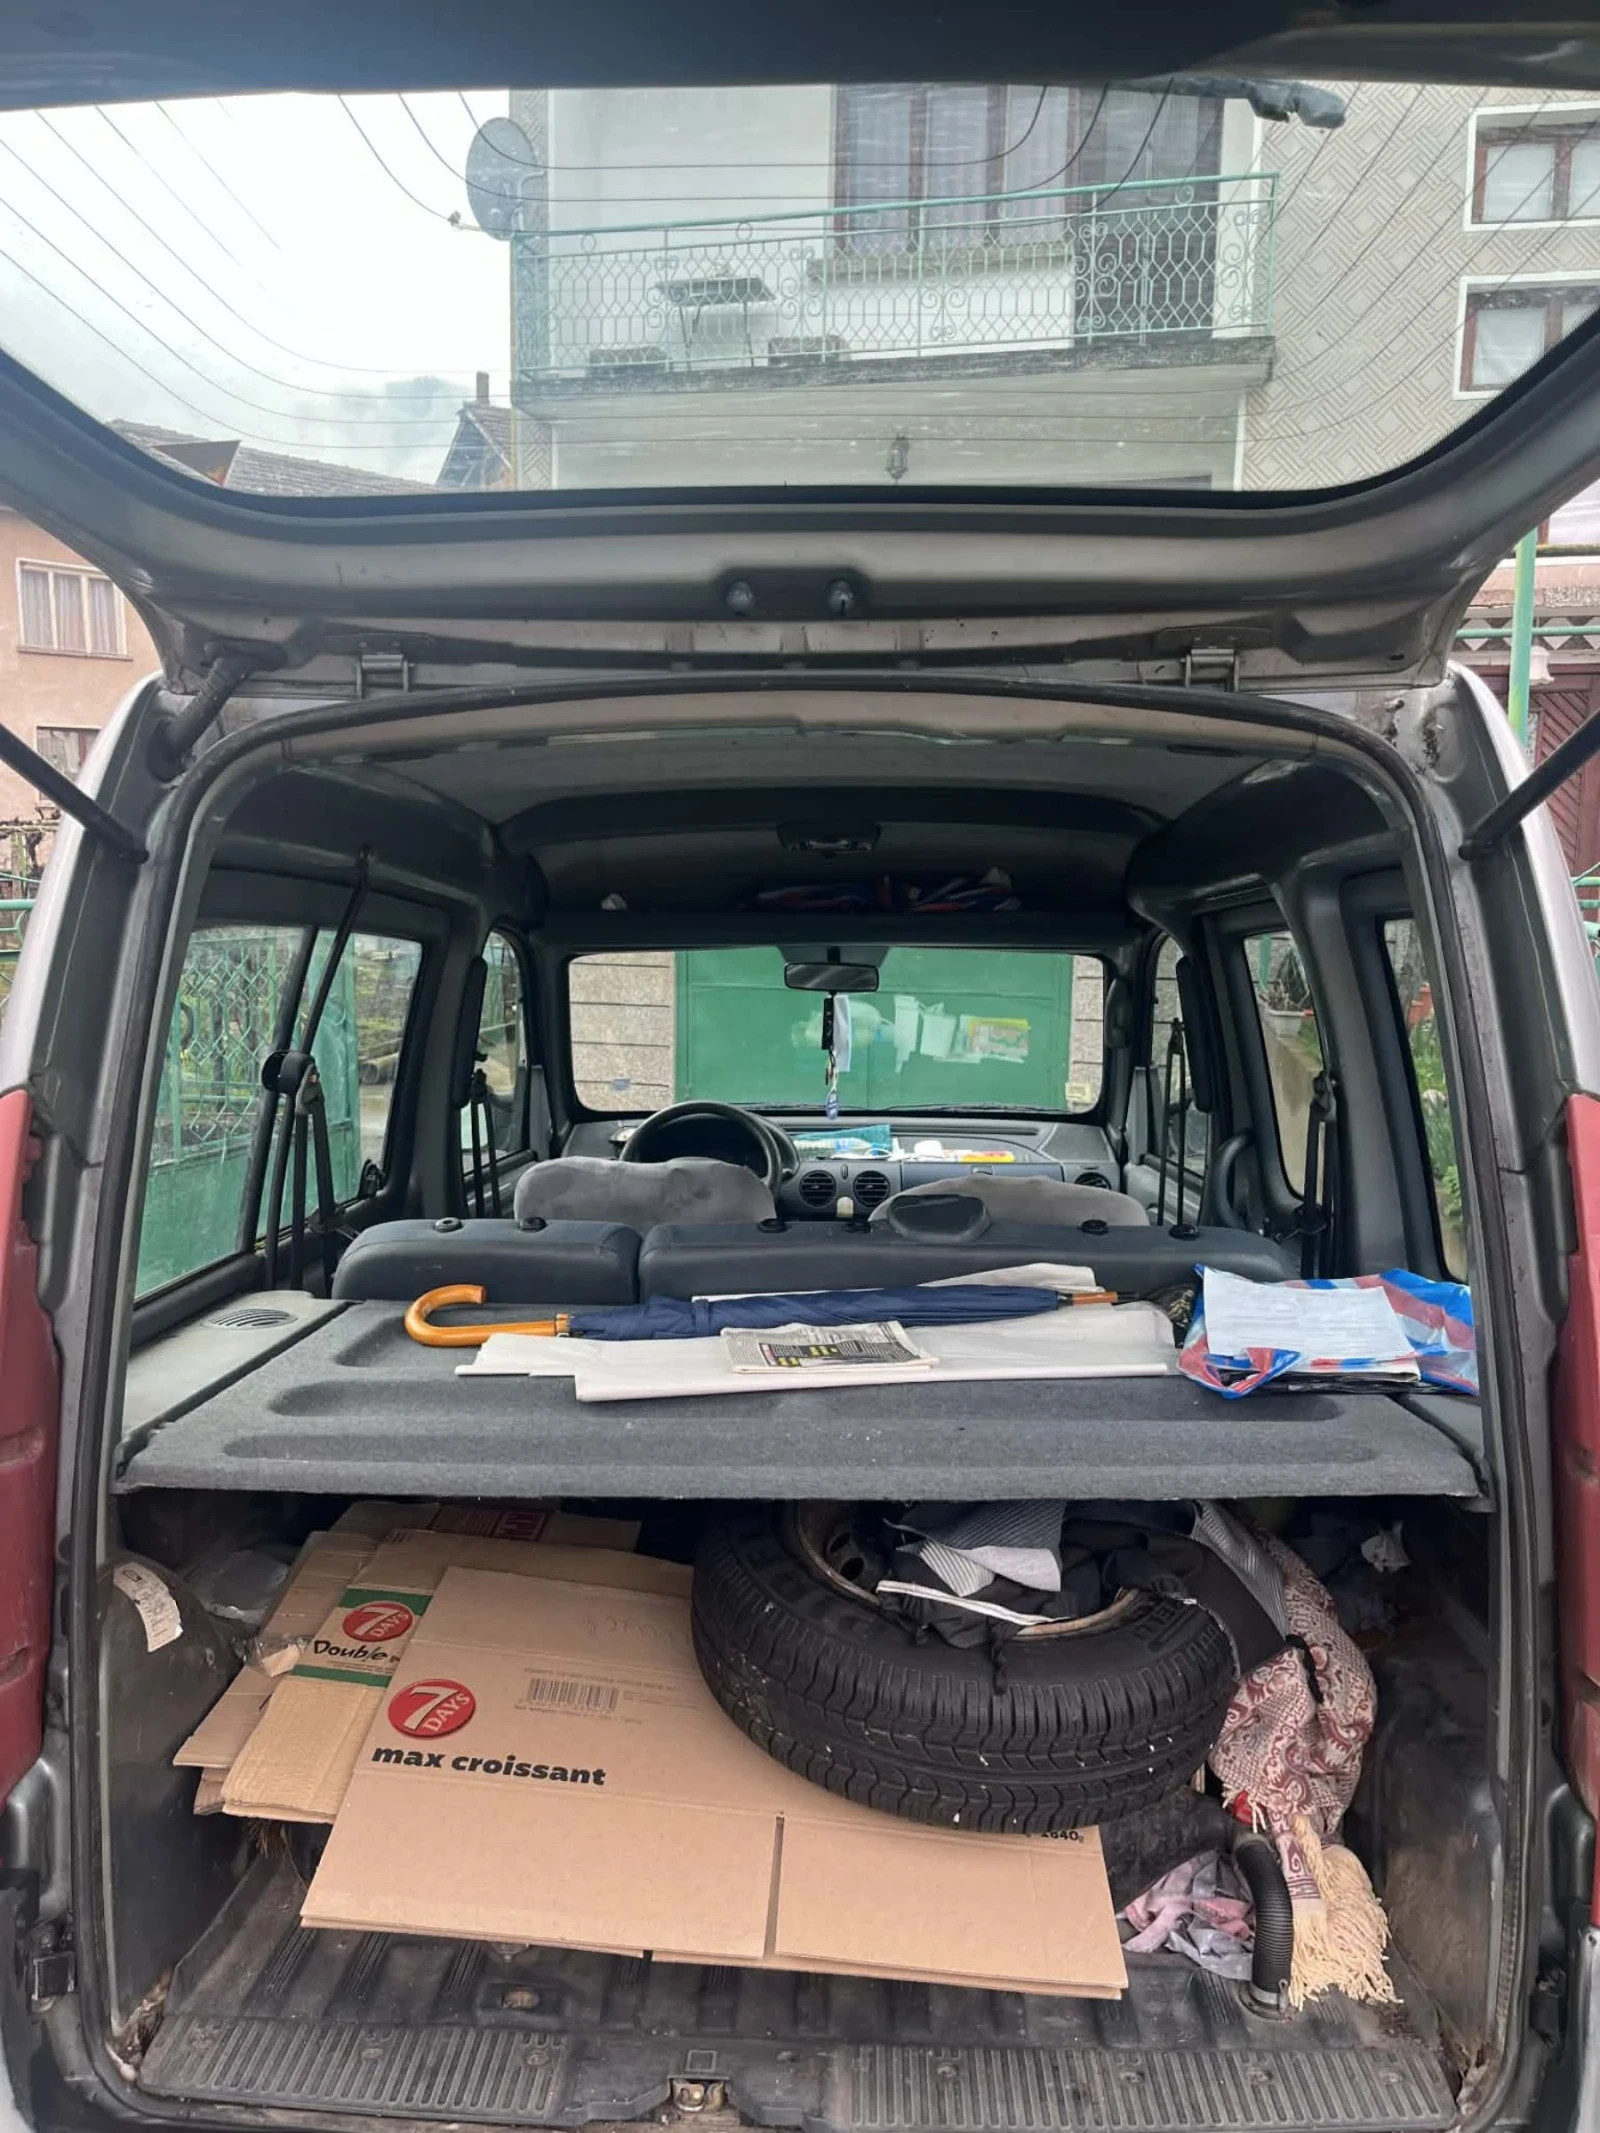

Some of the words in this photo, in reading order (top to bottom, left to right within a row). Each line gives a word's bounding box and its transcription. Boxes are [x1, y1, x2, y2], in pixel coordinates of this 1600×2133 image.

[354, 1606, 400, 1636] 7
[371, 1612, 409, 1638] DAYS
[314, 1640, 388, 1662] Double
[403, 1686, 460, 1732] 7
[422, 1693, 470, 1733] DAYS
[372, 1748, 445, 1769] max
[451, 1755, 607, 1786] croissant
